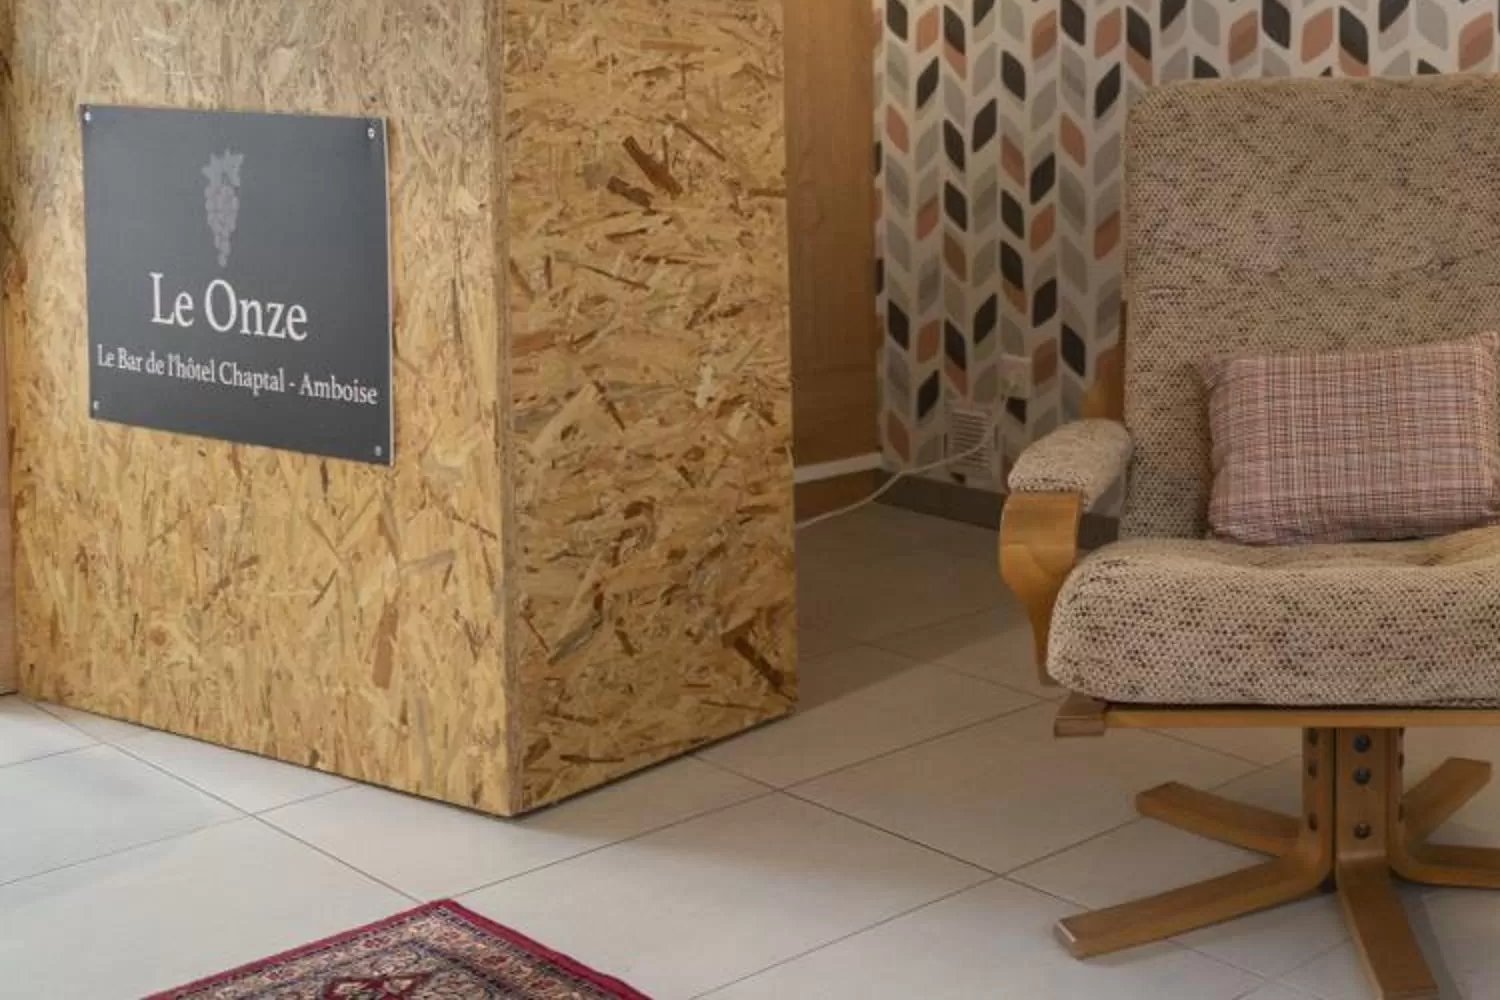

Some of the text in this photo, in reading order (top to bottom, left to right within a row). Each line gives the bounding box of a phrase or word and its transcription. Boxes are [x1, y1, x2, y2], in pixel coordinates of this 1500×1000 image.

[149, 271, 308, 341] Le Onze
[97, 344, 115, 366] Le
[117, 347, 143, 373] Bar
[145, 350, 165, 376] de
[167, 353, 215, 384] l'hôtel
[219, 362, 285, 396] Chaptal
[299, 373, 378, 405] Amboise
